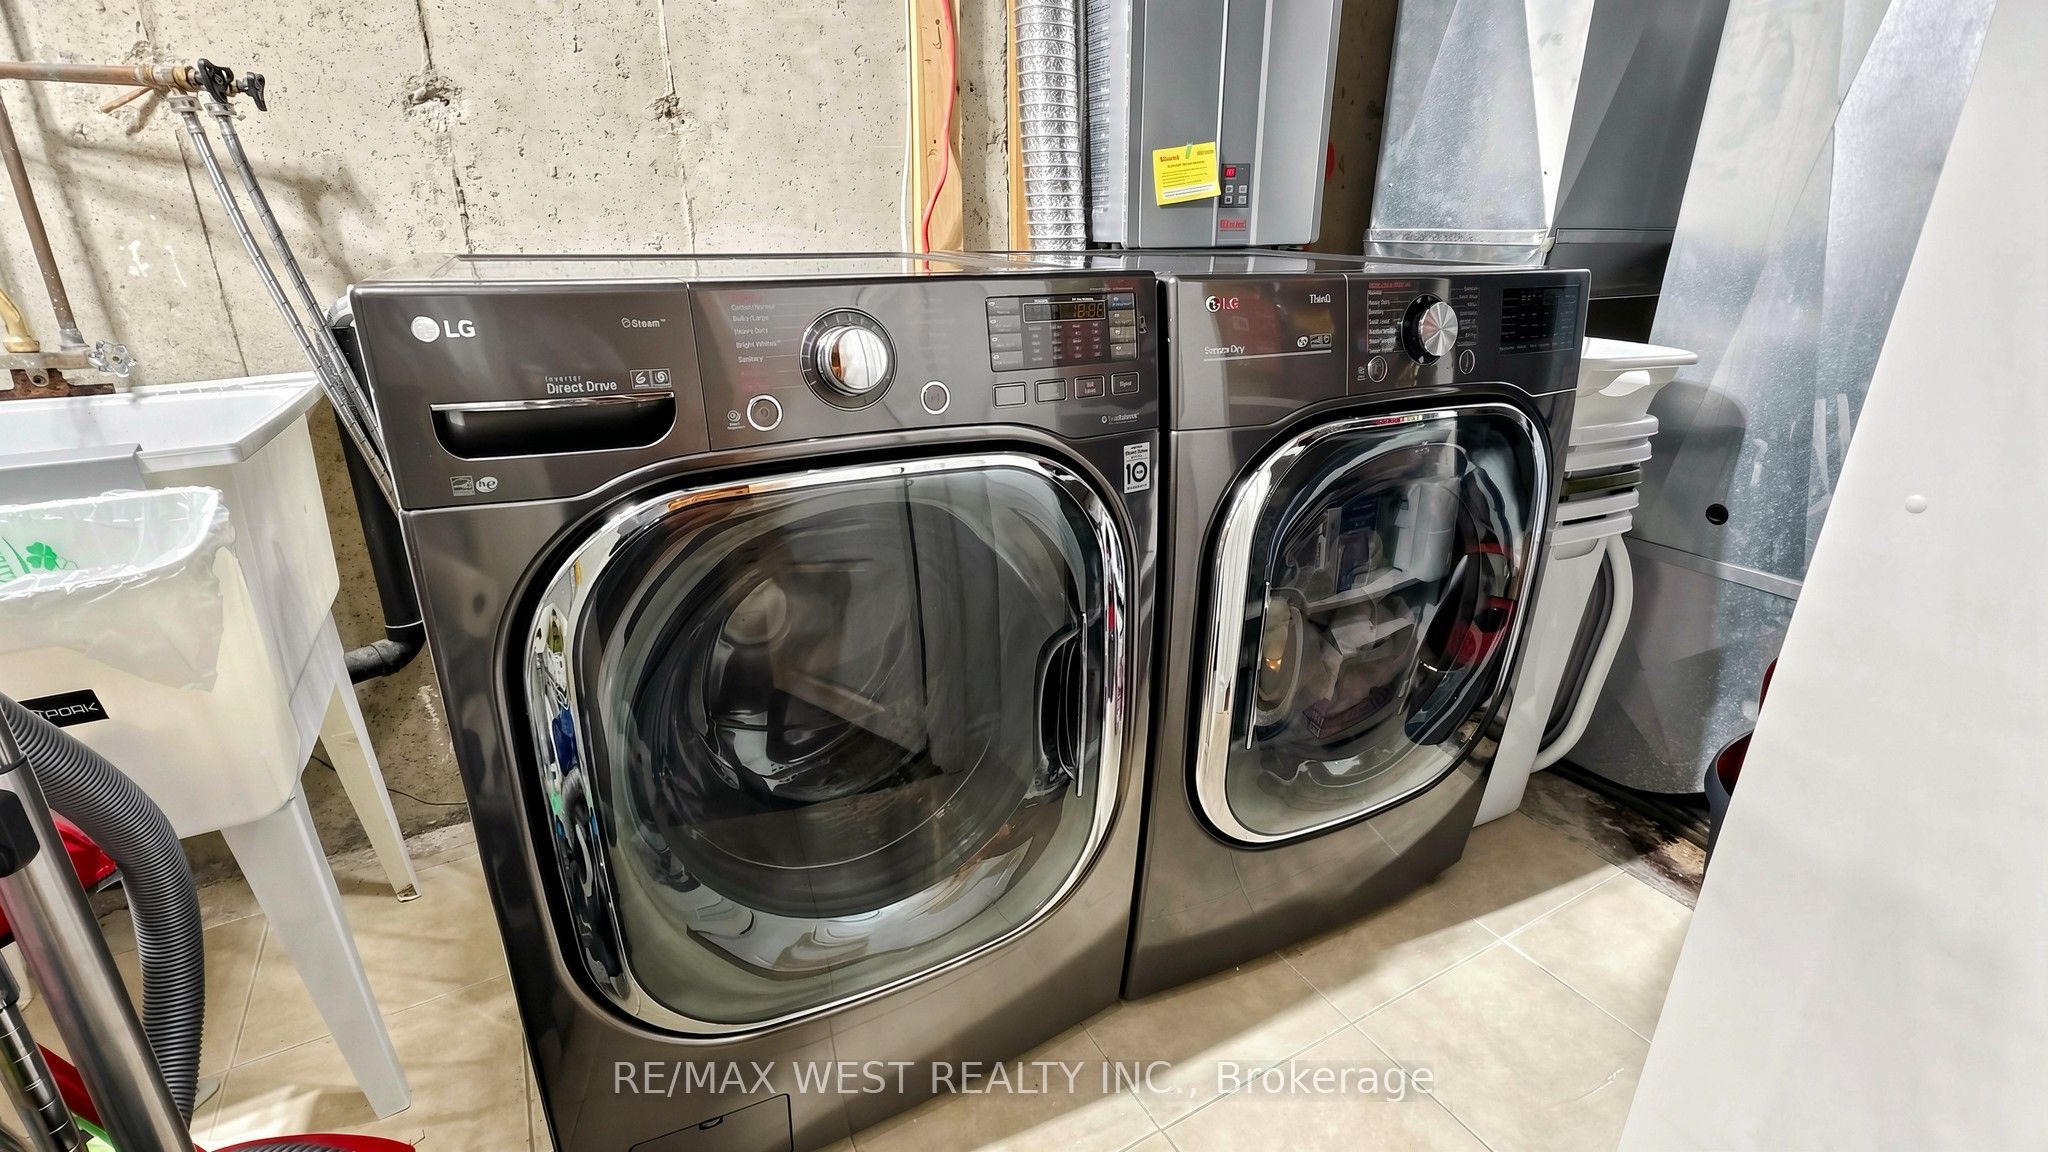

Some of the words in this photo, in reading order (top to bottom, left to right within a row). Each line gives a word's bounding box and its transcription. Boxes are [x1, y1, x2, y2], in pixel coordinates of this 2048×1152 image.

[443, 319, 476, 338] LG
[546, 382, 584, 394] Direct
[586, 380, 618, 392] Drive
[1126, 461, 1148, 485] 10
